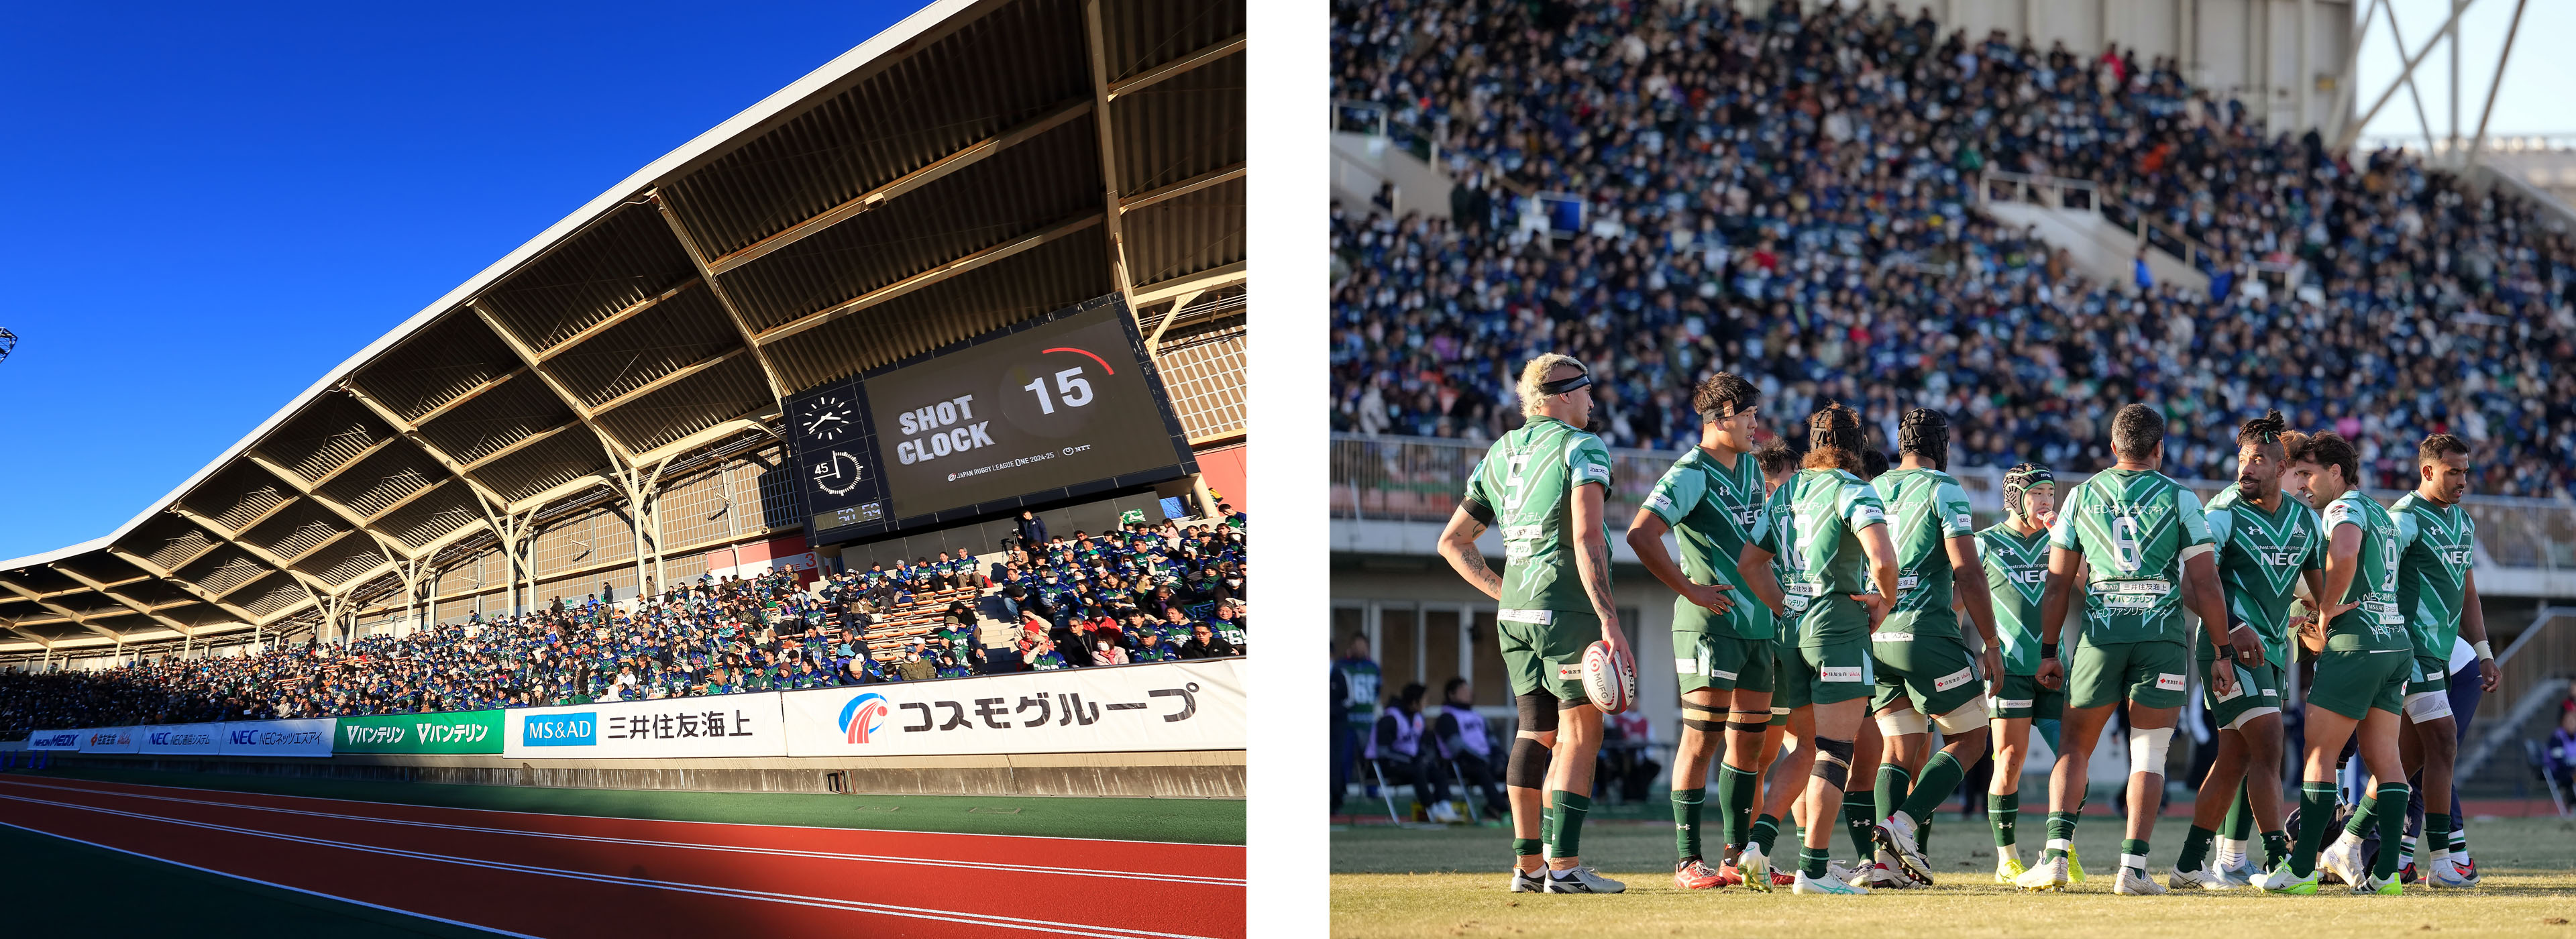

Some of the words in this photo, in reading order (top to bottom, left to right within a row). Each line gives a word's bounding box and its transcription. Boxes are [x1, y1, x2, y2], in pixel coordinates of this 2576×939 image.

[1025, 366, 1093, 415] 15
[899, 394, 974, 435] SHOT
[897, 421, 995, 465] CLOCK
[815, 463, 828, 474] 45
[957, 470, 973, 479] JAPAN
[974, 465, 991, 475] RUGBY
[991, 461, 1014, 471] LEAGUE
[1504, 454, 1529, 510] 5
[1732, 508, 1764, 526] NEC
[1779, 514, 1813, 571] 12
[2112, 516, 2141, 571] 6
[779, 563, 801, 573] GTE
[806, 553, 816, 567] 3
[2261, 553, 2300, 566] NEC
[2381, 538, 2398, 592] 9
[2442, 551, 2471, 565] NEC
[2008, 570, 2049, 584] NEC
[2123, 584, 2167, 592] 三井住友海上
[1594, 673, 1609, 699] MUFG
[899, 681, 1199, 732] コスモグループ
[529, 720, 592, 739] MS&AD
[607, 710, 752, 739] 三井住友海上
[51, 734, 78, 747] MEDIX
[149, 732, 171, 744] NEC
[229, 730, 258, 745] NEC
[259, 732, 322, 746] NECネッツエスアイ
